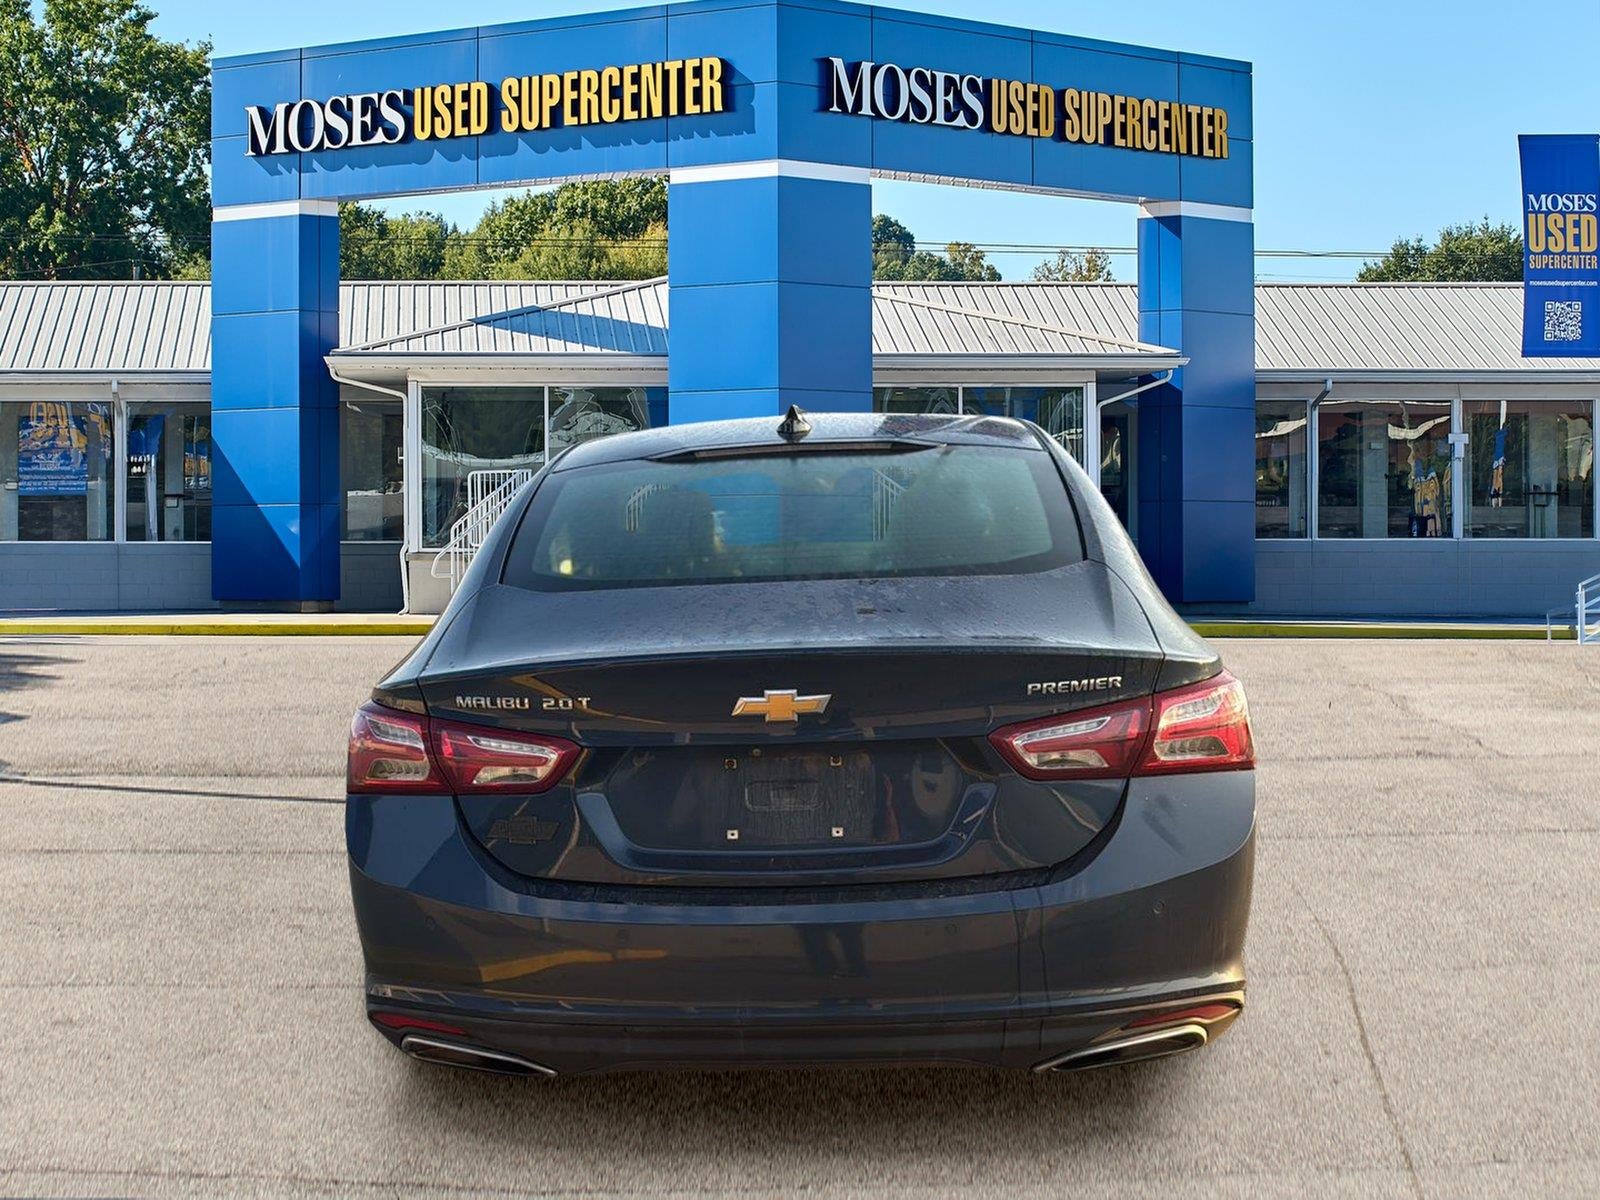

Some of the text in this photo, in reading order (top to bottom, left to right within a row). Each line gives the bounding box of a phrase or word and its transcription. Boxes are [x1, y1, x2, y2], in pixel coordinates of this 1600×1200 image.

[243, 56, 724, 157] MOSES USED SUPERCENTER
[828, 56, 1229, 159] MOSES USED SUPERCENTER
[1527, 193, 1597, 212] MOSES
[1528, 213, 1598, 253] USED
[1529, 254, 1598, 269] SUPERCENTER
[1027, 675, 1123, 696] PREMIER
[455, 695, 530, 710] MALIBU
